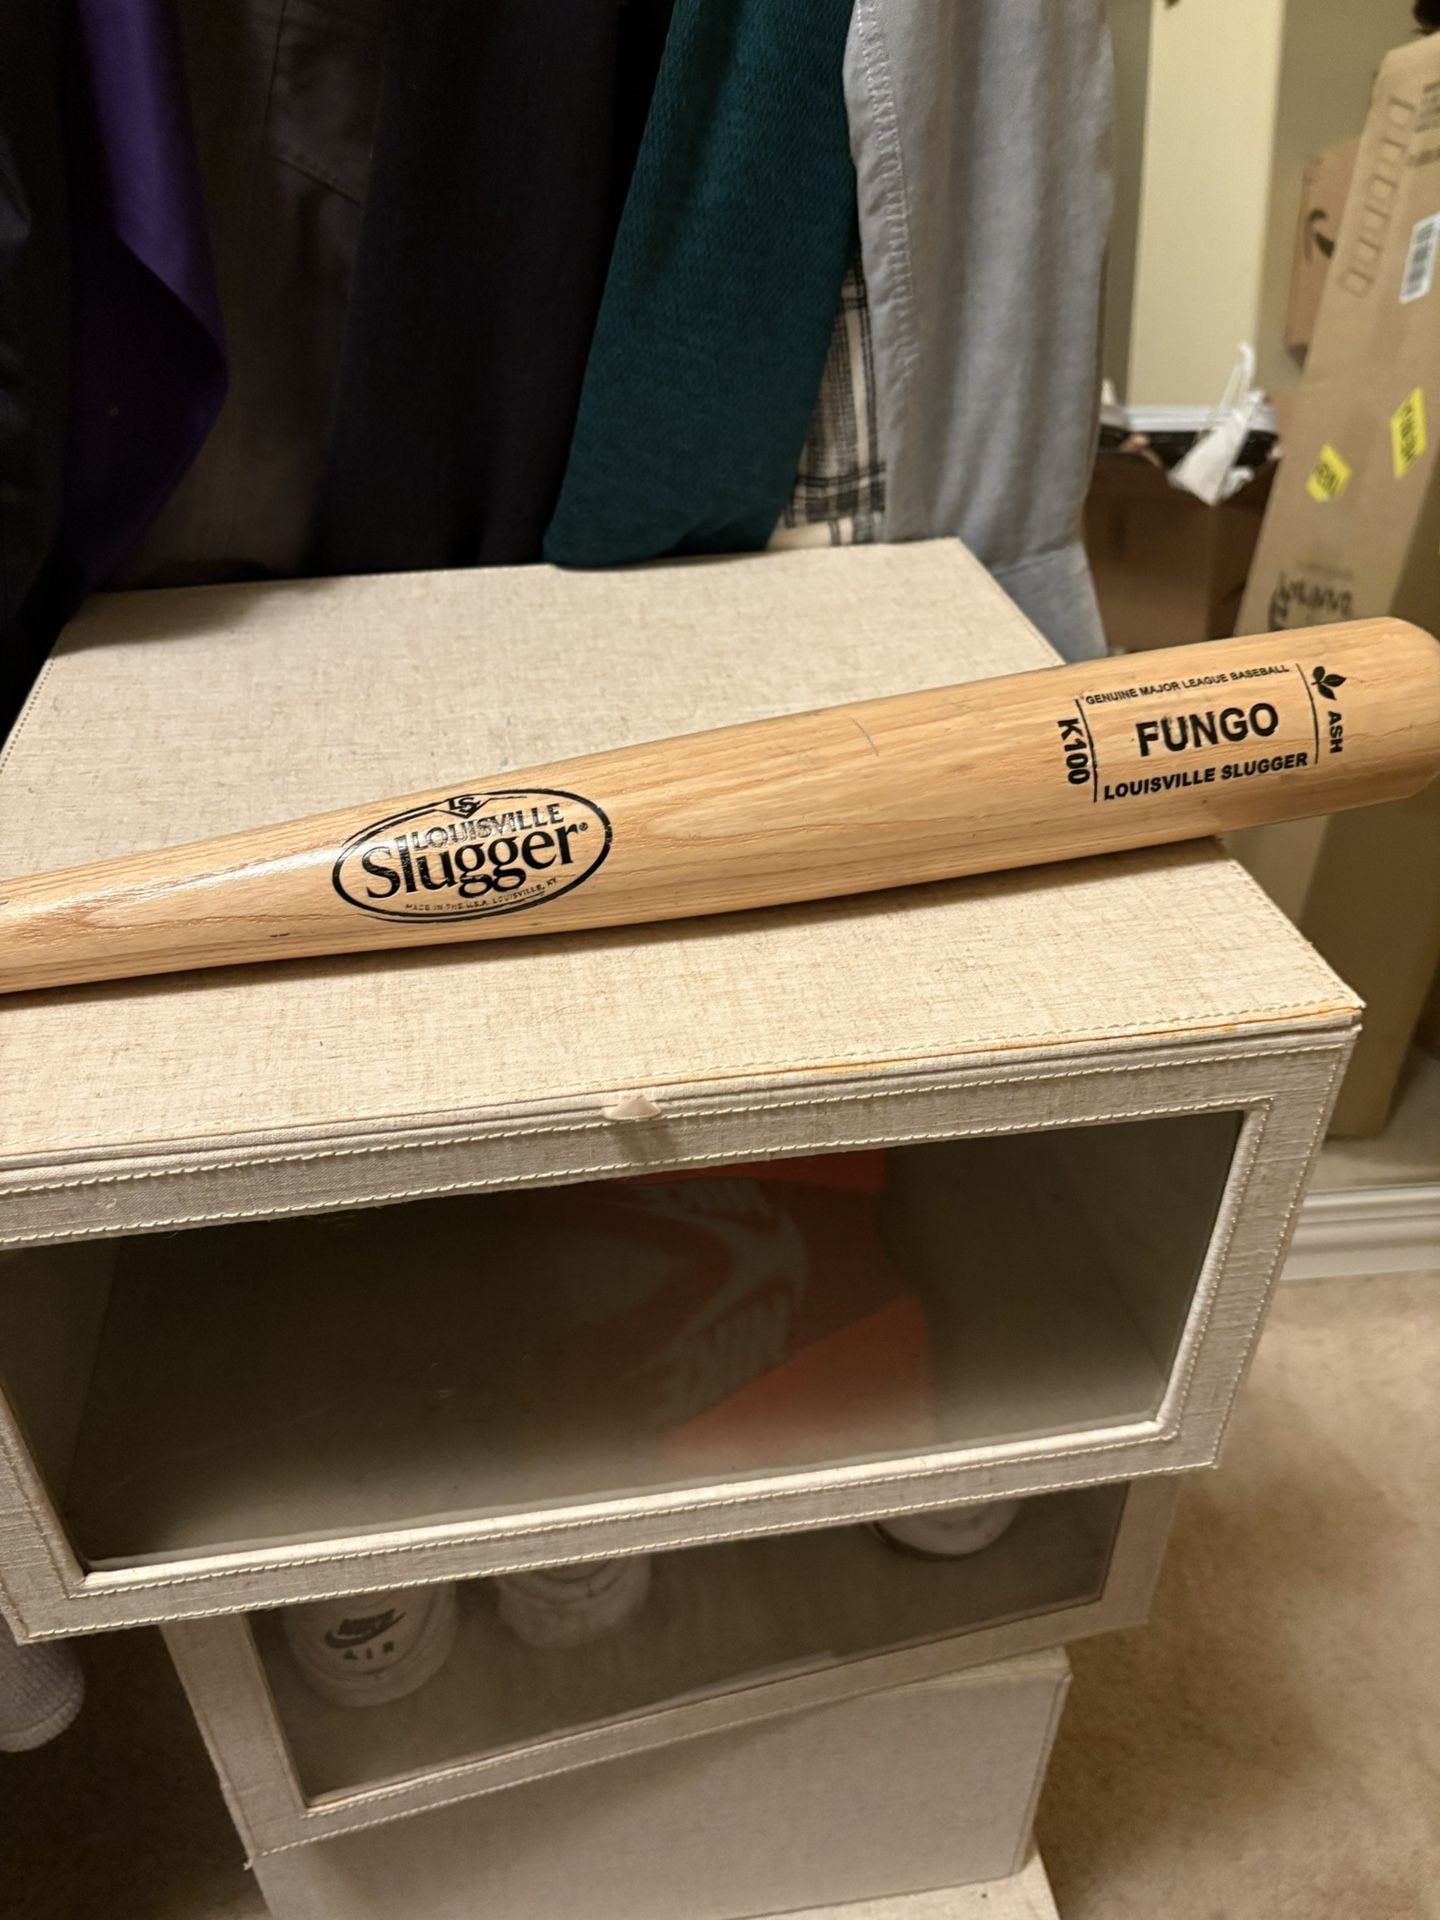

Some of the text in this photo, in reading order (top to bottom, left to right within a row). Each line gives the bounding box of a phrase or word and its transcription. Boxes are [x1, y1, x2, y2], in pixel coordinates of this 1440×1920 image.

[1086, 664, 1290, 706] GENUINE MAJOR LEAGUE BASEBALL
[1058, 718, 1090, 785] K100
[1136, 702, 1279, 757] FUNGO
[1327, 710, 1343, 754] ASH
[1104, 751, 1308, 801] LOUISVILLE SLUGGER
[413, 803, 565, 852] LOUISVILLE
[406, 903, 430, 912] MADE
[433, 904, 444, 912] IN
[446, 903, 463, 911] THE
[343, 1641, 394, 1662] AIR
